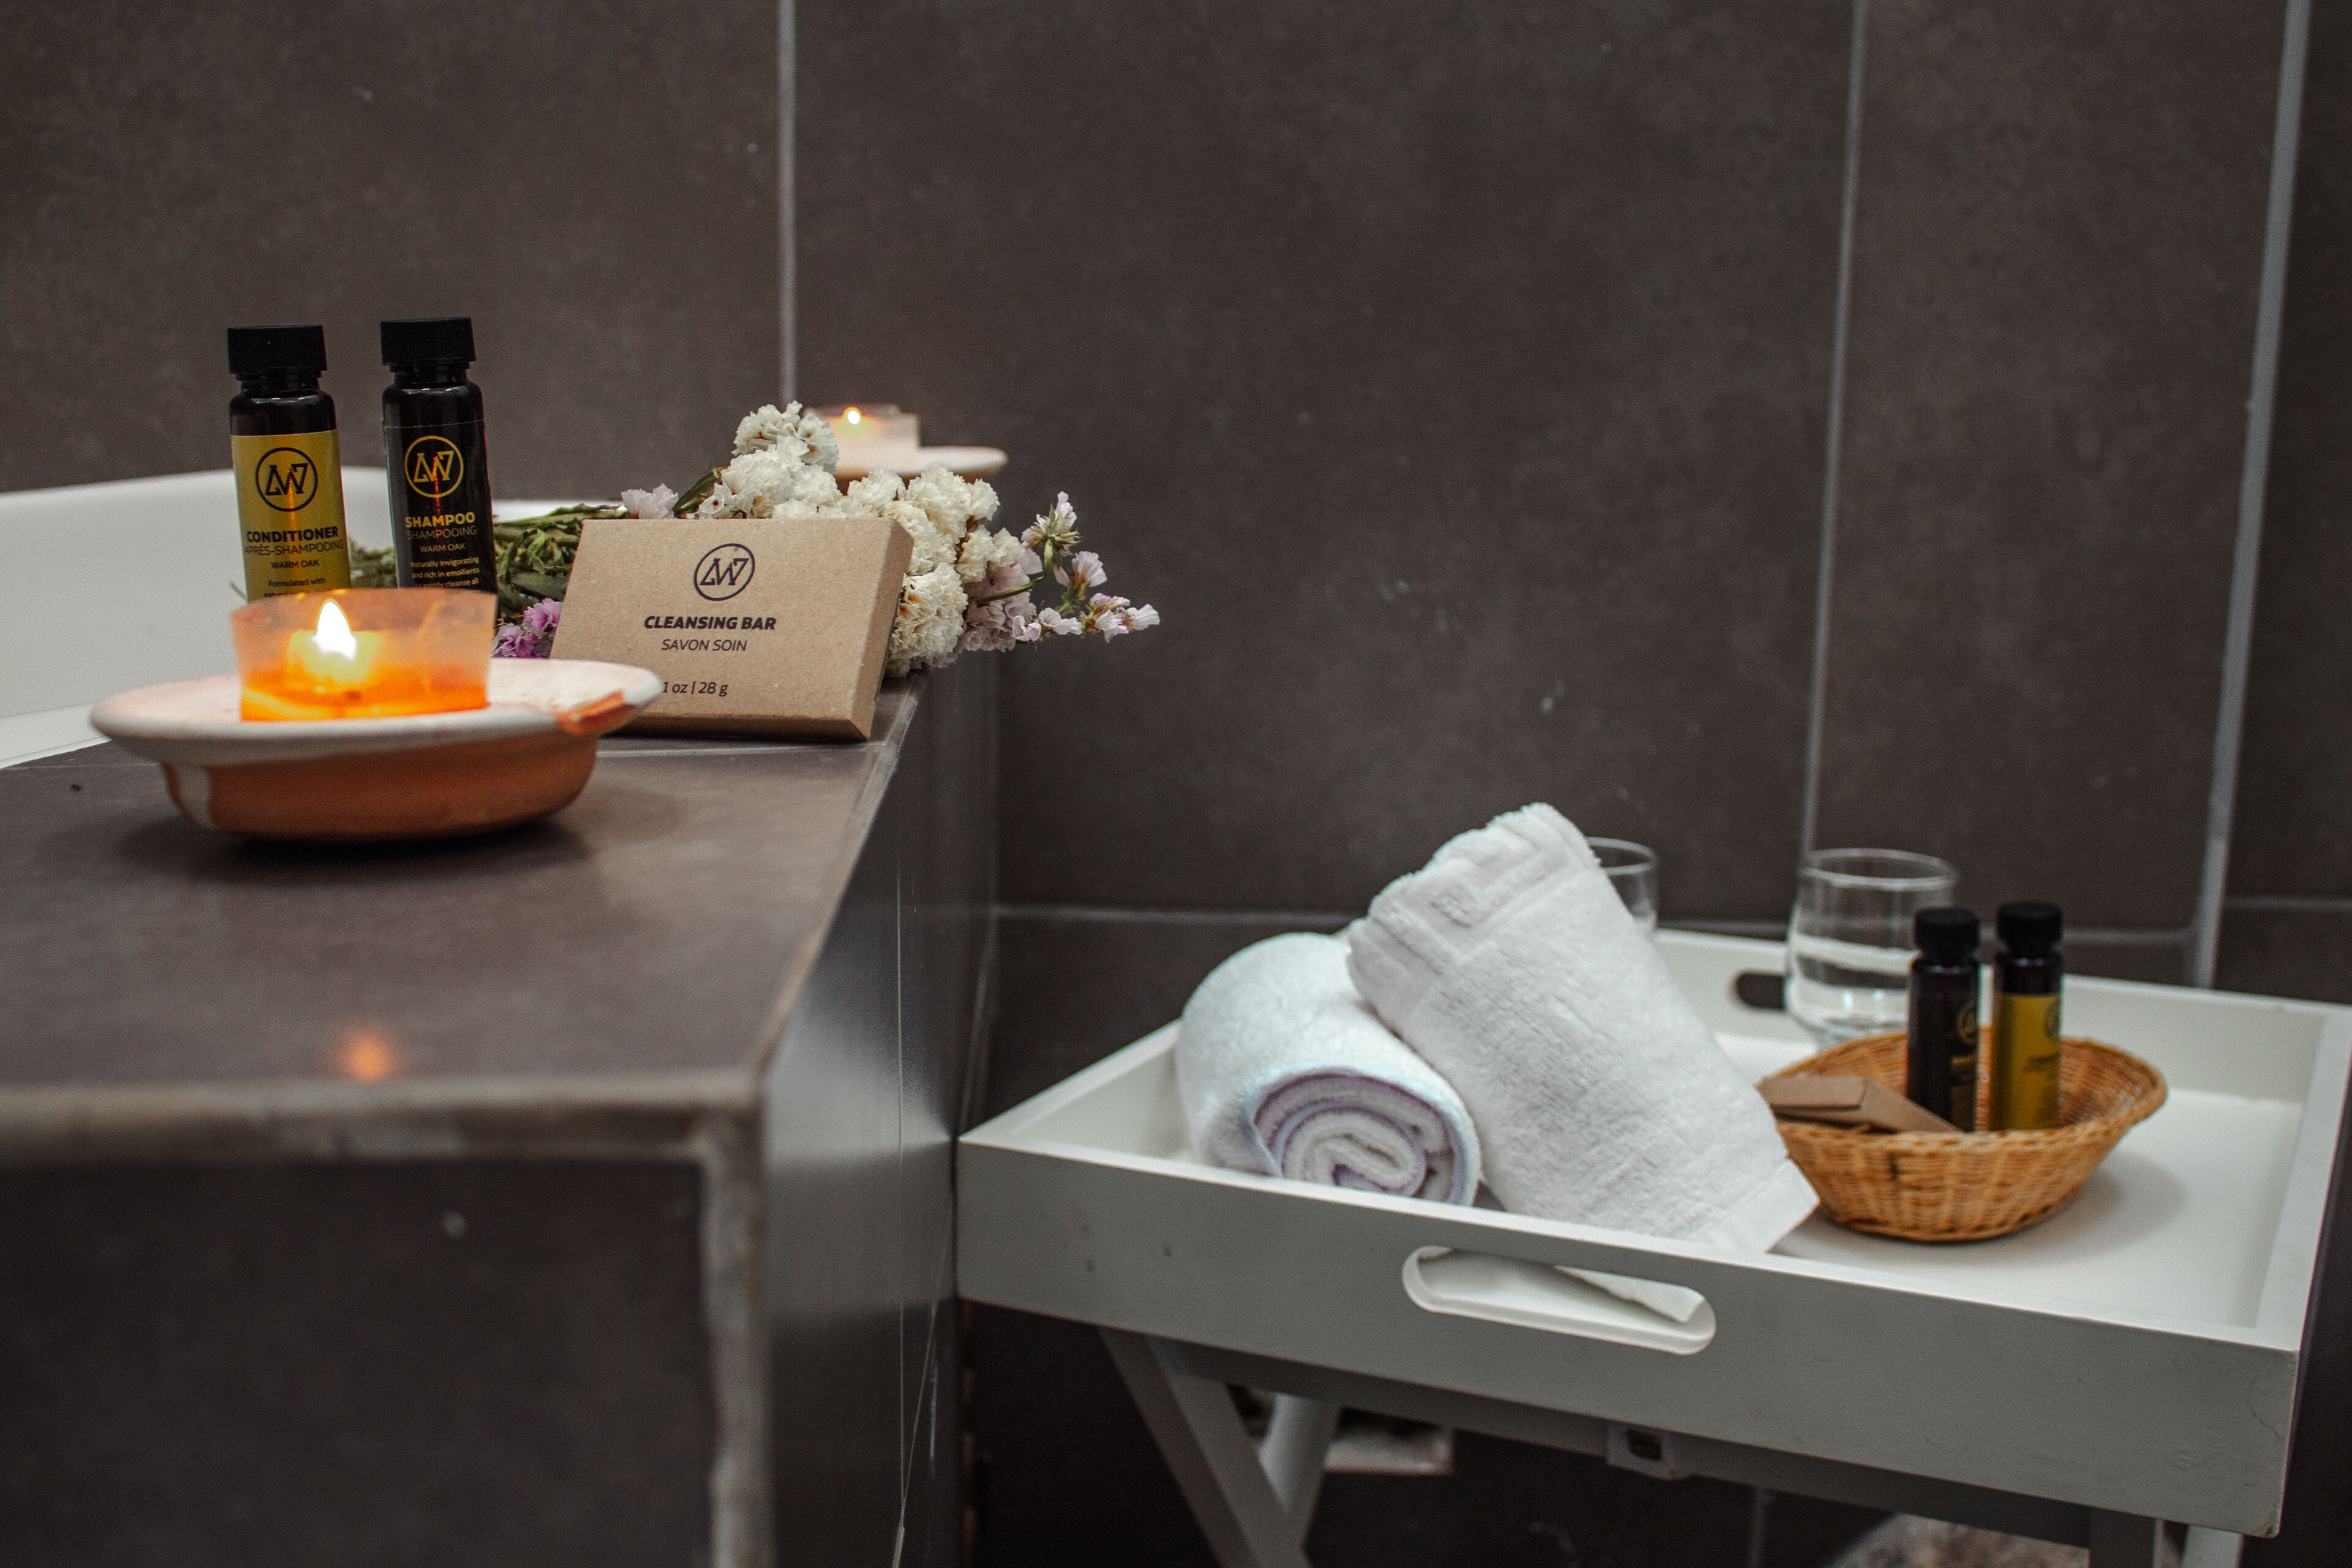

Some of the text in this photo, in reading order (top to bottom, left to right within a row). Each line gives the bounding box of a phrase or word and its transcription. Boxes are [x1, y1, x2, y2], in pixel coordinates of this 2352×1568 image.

[405, 511, 475, 527] SHAMPOO
[247, 526, 339, 543] CONDITIONER
[407, 525, 477, 540] SHAMPOOING
[447, 543, 466, 551] OAK
[271, 559, 320, 569] WARM OAK
[644, 616, 777, 630] CLEANSING BAR
[661, 639, 748, 652] SAVON SOIN
[662, 681, 668, 693] 1
[671, 684, 688, 693] oz
[698, 682, 717, 694] 28
[718, 684, 729, 697] g
